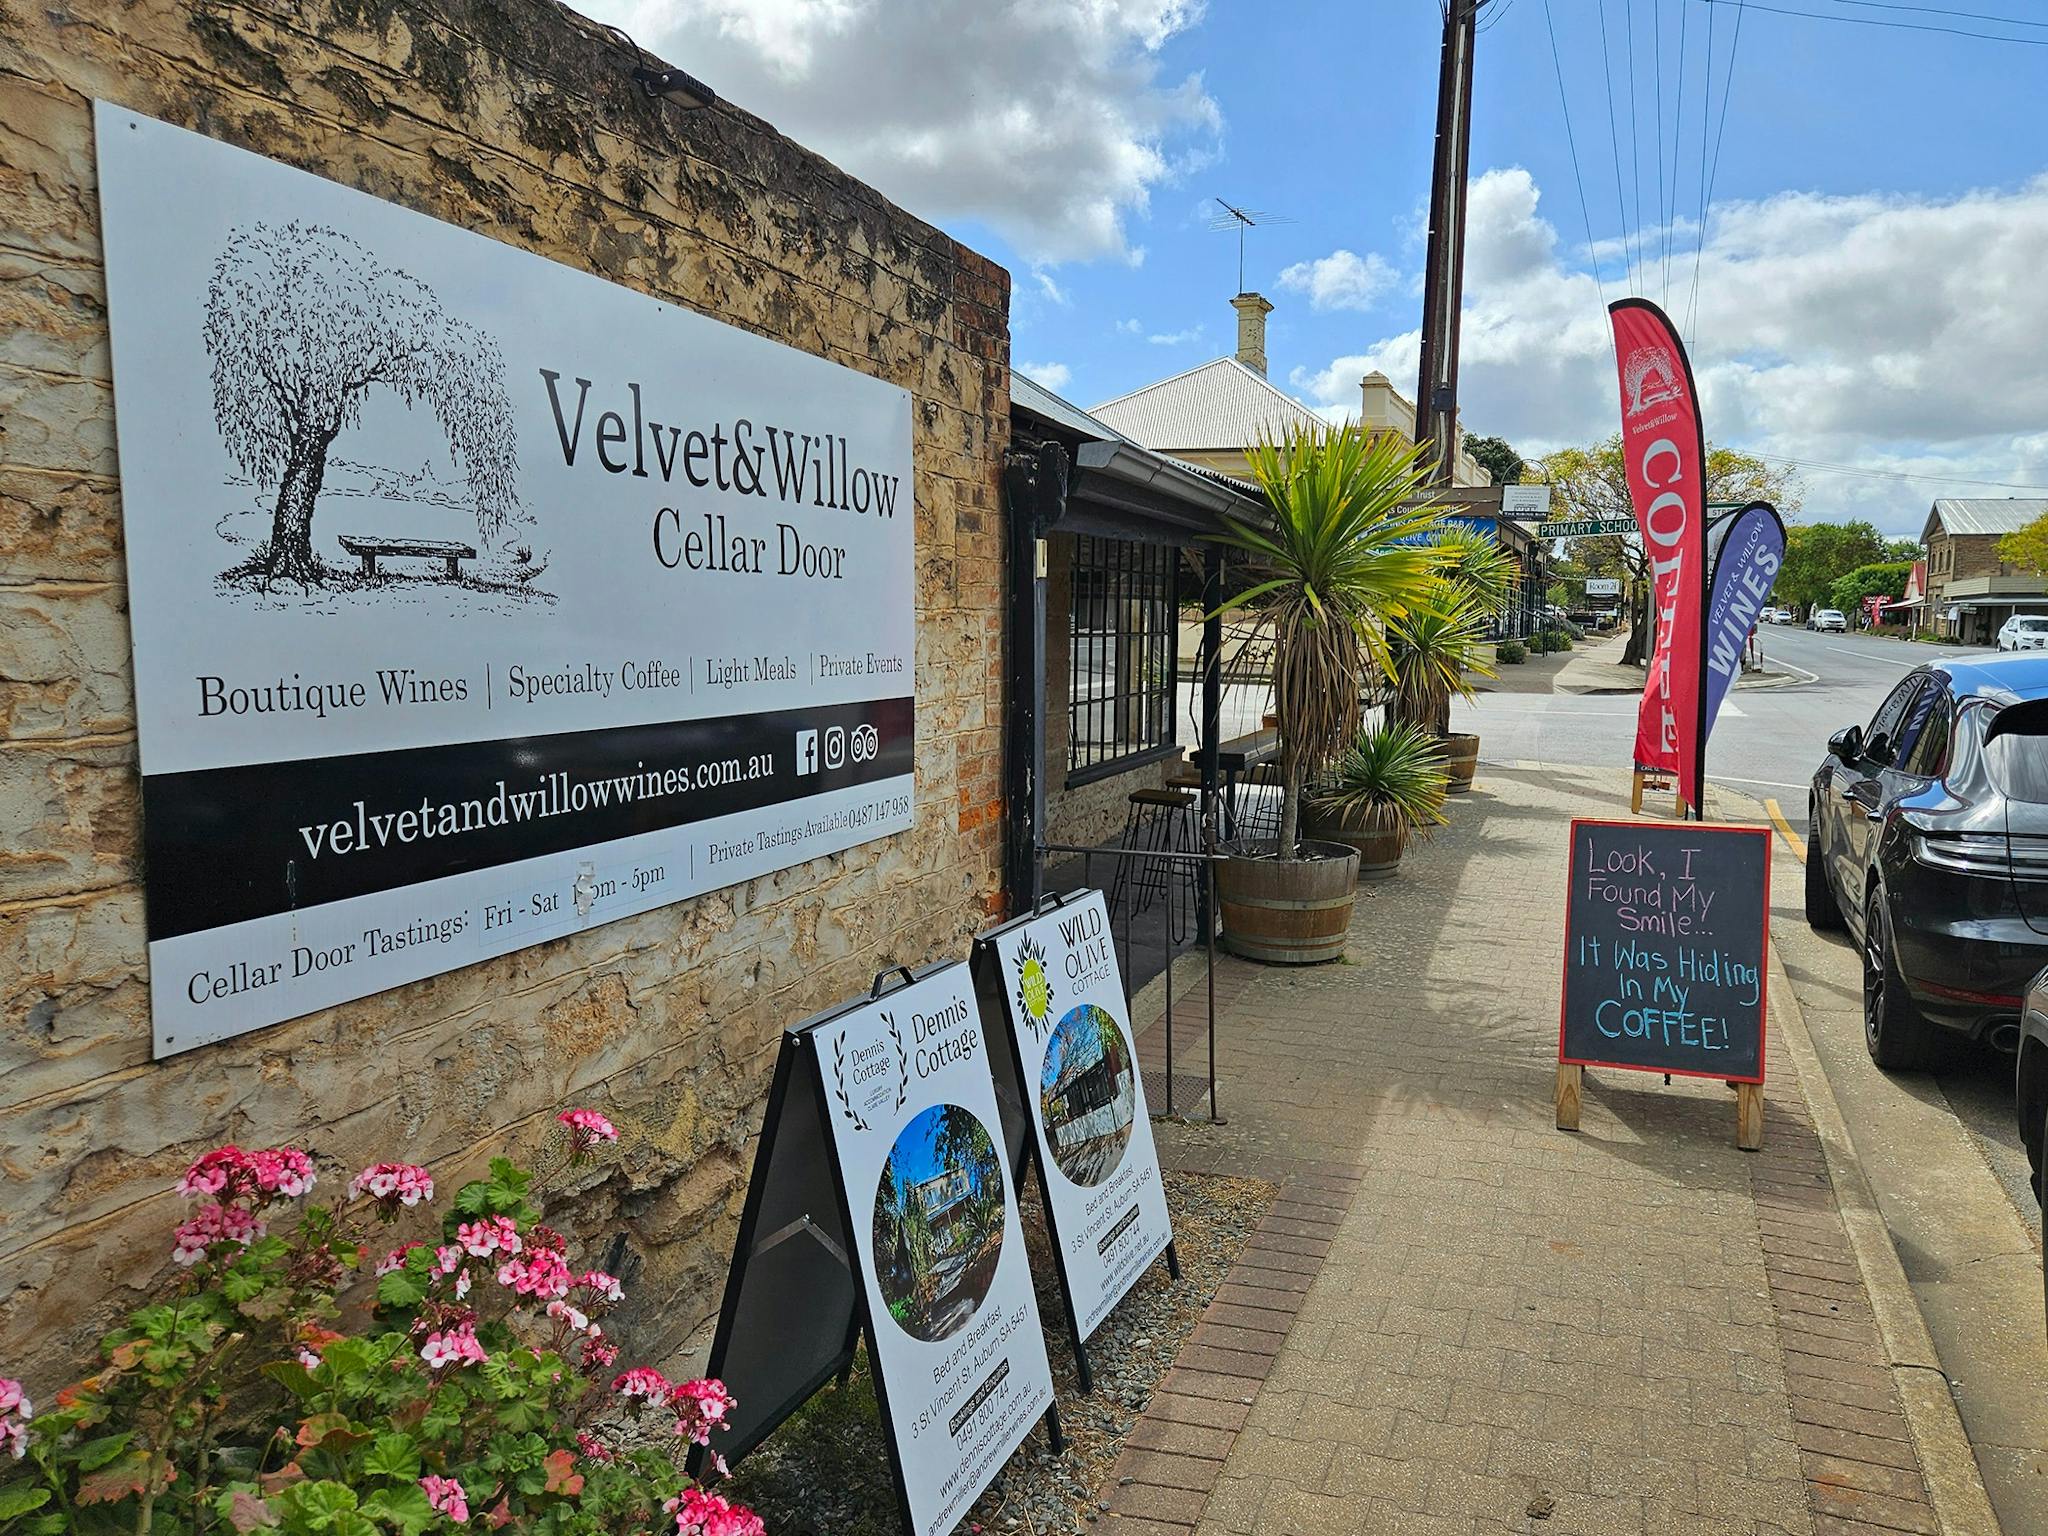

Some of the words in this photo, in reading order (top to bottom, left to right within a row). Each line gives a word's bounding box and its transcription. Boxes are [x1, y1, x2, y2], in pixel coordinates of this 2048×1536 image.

[539, 368, 899, 519] Velvet&Willow
[653, 507, 766, 574] Cellar
[777, 523, 845, 579] Door
[1541, 522, 1593, 536] PRIMARY
[1599, 520, 1639, 533] SCHOO
[1712, 579, 1734, 625] VELVET
[1732, 572, 1740, 583] &
[1738, 517, 1764, 569] WILLOW
[1708, 544, 1779, 677] WINES
[196, 673, 366, 718] Boutique
[376, 669, 468, 705] Wines
[508, 663, 614, 703] Specialty
[622, 660, 680, 690] Coffee
[706, 658, 748, 690] Light
[753, 656, 797, 682] Meals
[819, 655, 863, 678] Private
[866, 652, 902, 675] Events
[299, 752, 774, 860] velvetandwillowwines.com.au
[1678, 849, 1702, 880] I
[188, 962, 281, 1005] Cellar
[291, 942, 355, 979] Door
[364, 909, 469, 960] Tastings:
[484, 900, 512, 931] Fri
[531, 891, 559, 917] Sat
[632, 866, 665, 892] 5pm
[708, 840, 754, 865] Private
[756, 827, 802, 851] Tastings
[804, 812, 847, 838] Available
[848, 804, 873, 830] 0487
[875, 800, 890, 821] 147
[892, 795, 909, 817] 958
[1588, 877, 1661, 909] Found
[1672, 883, 1715, 922] My
[1058, 907, 1102, 949] WILD
[1065, 936, 1109, 980] OLIVE
[1071, 963, 1111, 996] COTTAGE
[1580, 935, 1601, 967] It
[1614, 939, 1668, 972] Was
[1679, 945, 1760, 1006] Hiding
[912, 995, 968, 1045] Dennis
[1619, 973, 1643, 1000] In
[1653, 976, 1689, 1019] My
[1595, 1000, 1730, 1050] COFFEE!
[851, 1038, 885, 1067] Dennis
[853, 1057, 891, 1085] Cottage
[915, 1028, 978, 1079] Cottage
[1085, 1196, 1098, 1216] Bed
[1098, 1188, 1109, 1205] and
[1071, 1240, 1077, 1254] 3
[1084, 1213, 1106, 1240] Vincent
[1103, 1244, 1118, 1269] 0491
[1118, 1232, 1130, 1253] 800
[1129, 1220, 1140, 1239] 744
[932, 1356, 951, 1384] Bed
[953, 1340, 967, 1366] and
[966, 1305, 1002, 1349] Breakfast
[911, 1422, 919, 1439] 3
[919, 1409, 931, 1430] St
[930, 1376, 962, 1417] Vincent
[961, 1365, 974, 1384] St.
[974, 1336, 1000, 1373] Auburn
[1000, 1325, 1012, 1342] SA
[1010, 1304, 1028, 1331] 5451
[950, 1400, 975, 1432] Bookings
[974, 1387, 986, 1406] and
[956, 1416, 978, 1451] 0491
[978, 1398, 994, 1426] 800
[993, 1380, 1010, 1407] 744
[939, 1381, 1032, 1498] www.denniscottage.com.au
